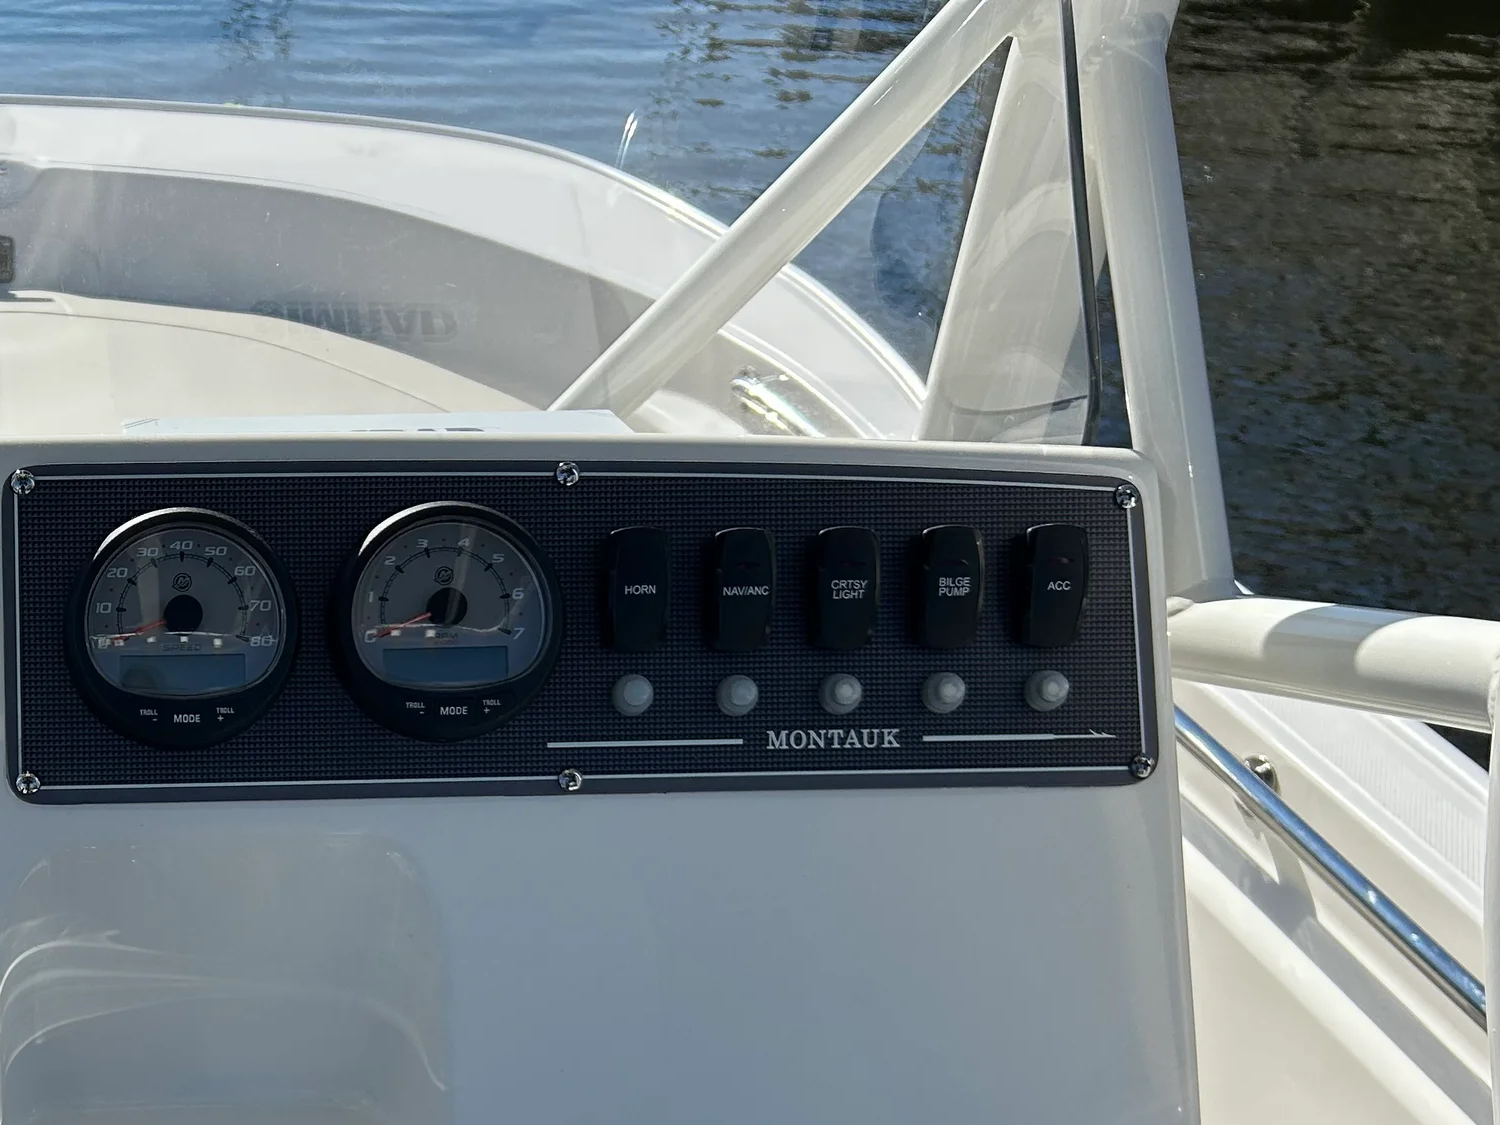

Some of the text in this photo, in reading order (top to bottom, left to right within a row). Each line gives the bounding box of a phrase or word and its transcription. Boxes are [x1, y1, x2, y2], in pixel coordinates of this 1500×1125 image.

[170, 541, 193, 549] 40
[417, 539, 428, 548] 3
[458, 538, 470, 547] 4
[136, 547, 159, 557] 30
[204, 547, 227, 556] 50
[385, 556, 396, 565] 2
[493, 554, 504, 563] 5
[107, 568, 128, 577] 20
[234, 566, 255, 575] 60
[831, 579, 868, 590] CRTSY
[938, 577, 971, 587] BILGE
[1047, 580, 1071, 591] ACC
[512, 588, 524, 600] 6
[624, 584, 656, 594] HORN
[723, 585, 769, 596] NAV/ANC
[832, 589, 865, 599] LIGHT
[938, 586, 970, 597] PUMP
[368, 591, 374, 602] 1
[96, 602, 111, 613] 10
[250, 600, 271, 611] 70
[513, 627, 524, 639] 7
[162, 644, 201, 652] SPEED
[440, 706, 468, 715] MODE
[174, 714, 201, 722] MODE
[766, 728, 900, 749] MONTAUK
